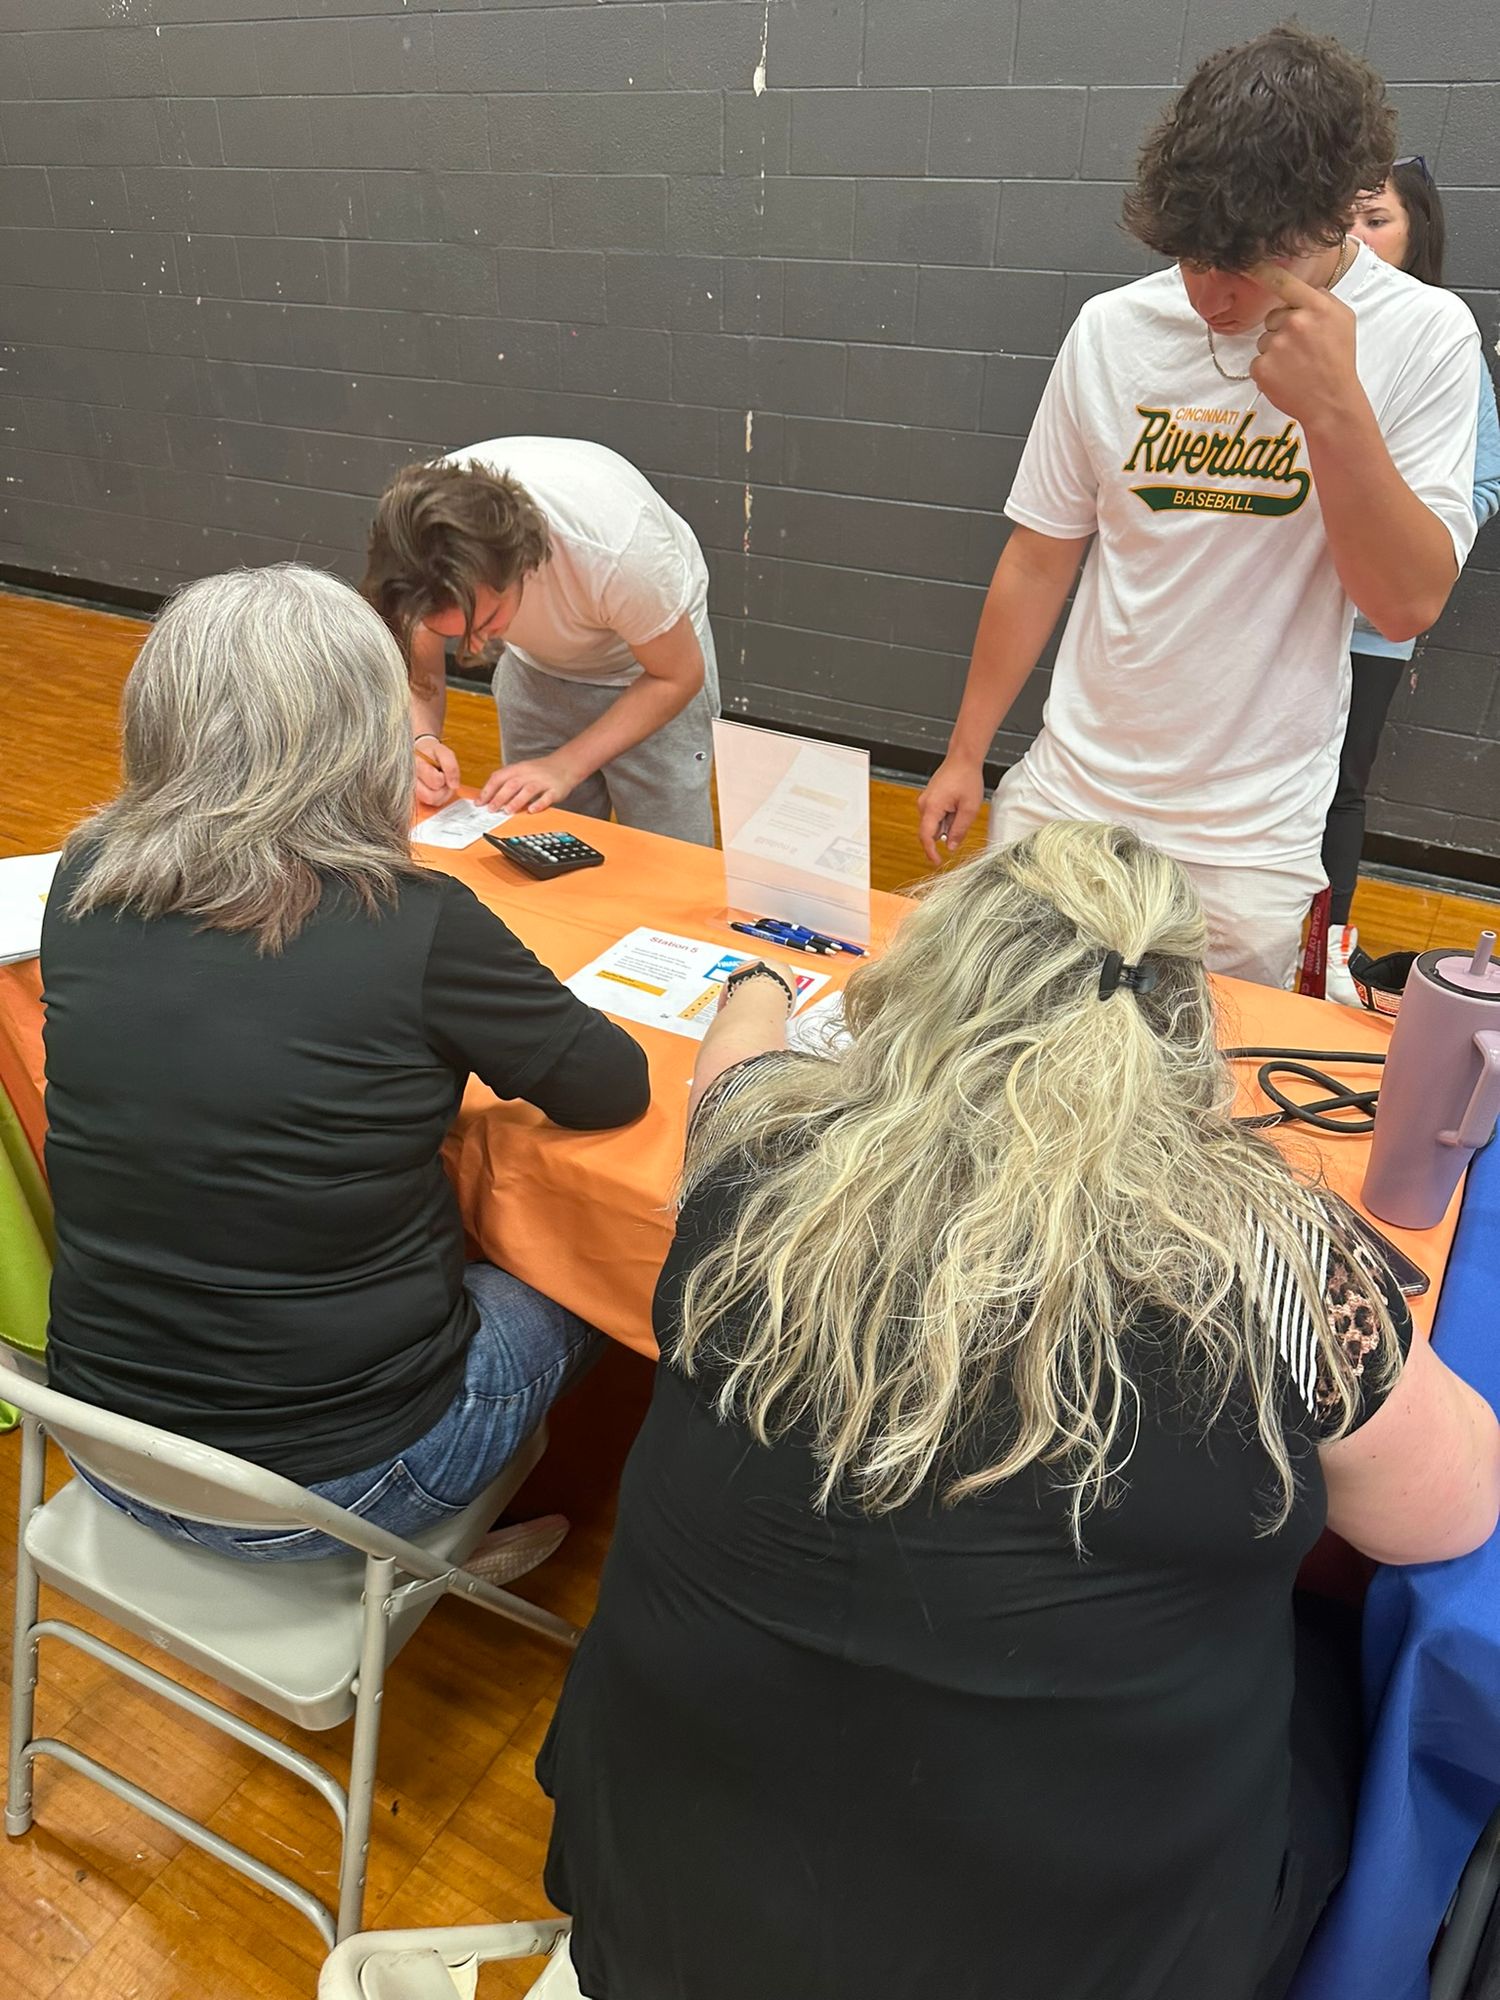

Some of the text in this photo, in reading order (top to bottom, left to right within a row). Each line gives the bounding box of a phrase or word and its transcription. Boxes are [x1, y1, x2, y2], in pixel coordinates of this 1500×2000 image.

[1175, 407, 1240, 425] CINCINNATI
[1122, 404, 1300, 484] Riverbats
[1173, 490, 1254, 511] BASEBALL
[650, 937, 689, 951] Station
